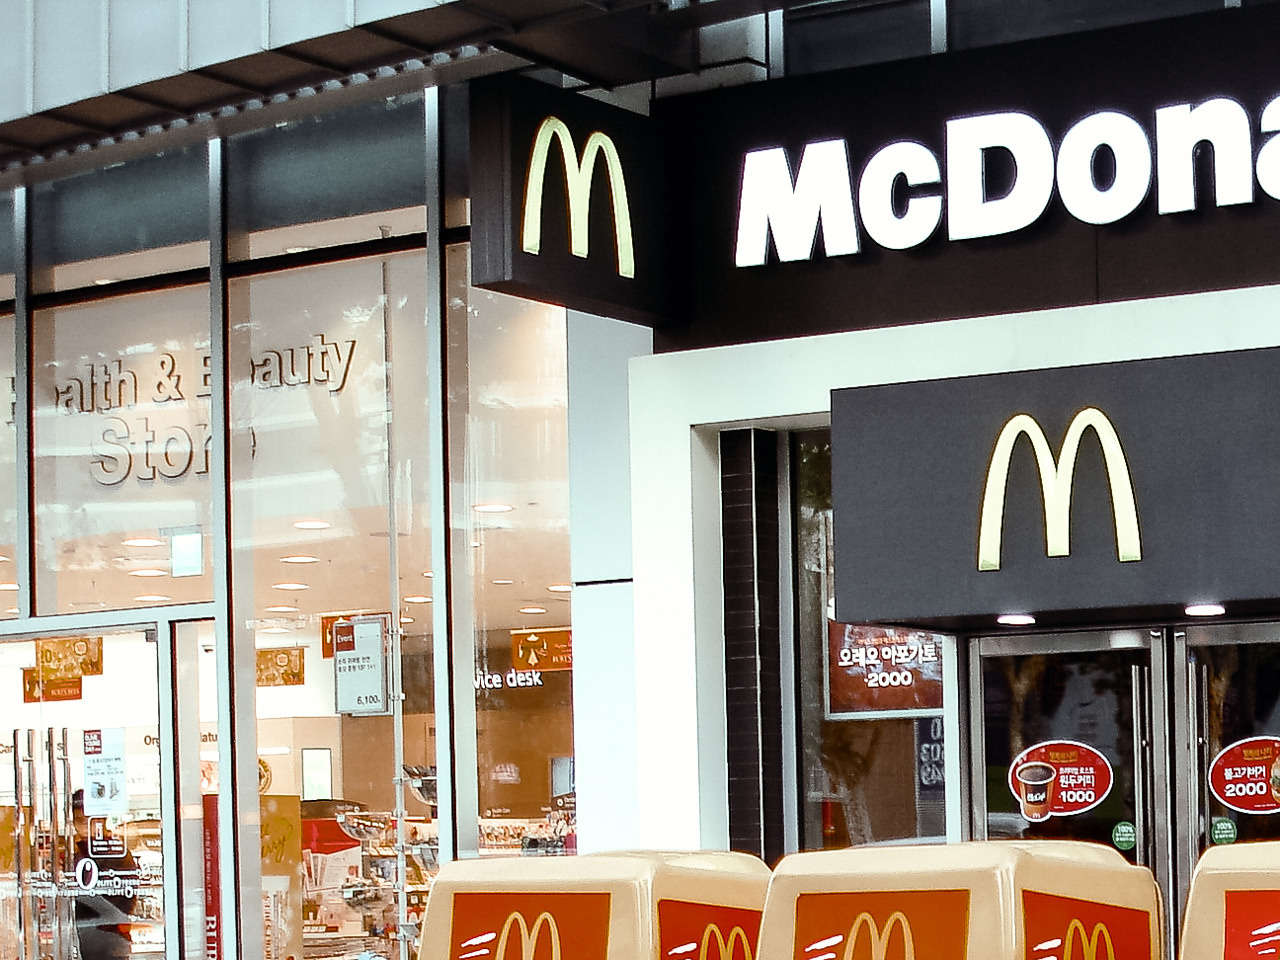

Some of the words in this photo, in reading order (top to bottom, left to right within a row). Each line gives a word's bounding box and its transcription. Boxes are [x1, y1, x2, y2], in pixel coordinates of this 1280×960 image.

[90, 417, 256, 487] Stor
[838, 647, 880, 668] 오레오
[881, 644, 938, 666] 아포가토
[507, 667, 545, 688] desk
[1059, 775, 1095, 787] 원두커피
[1224, 765, 1266, 780] 불고기버거
